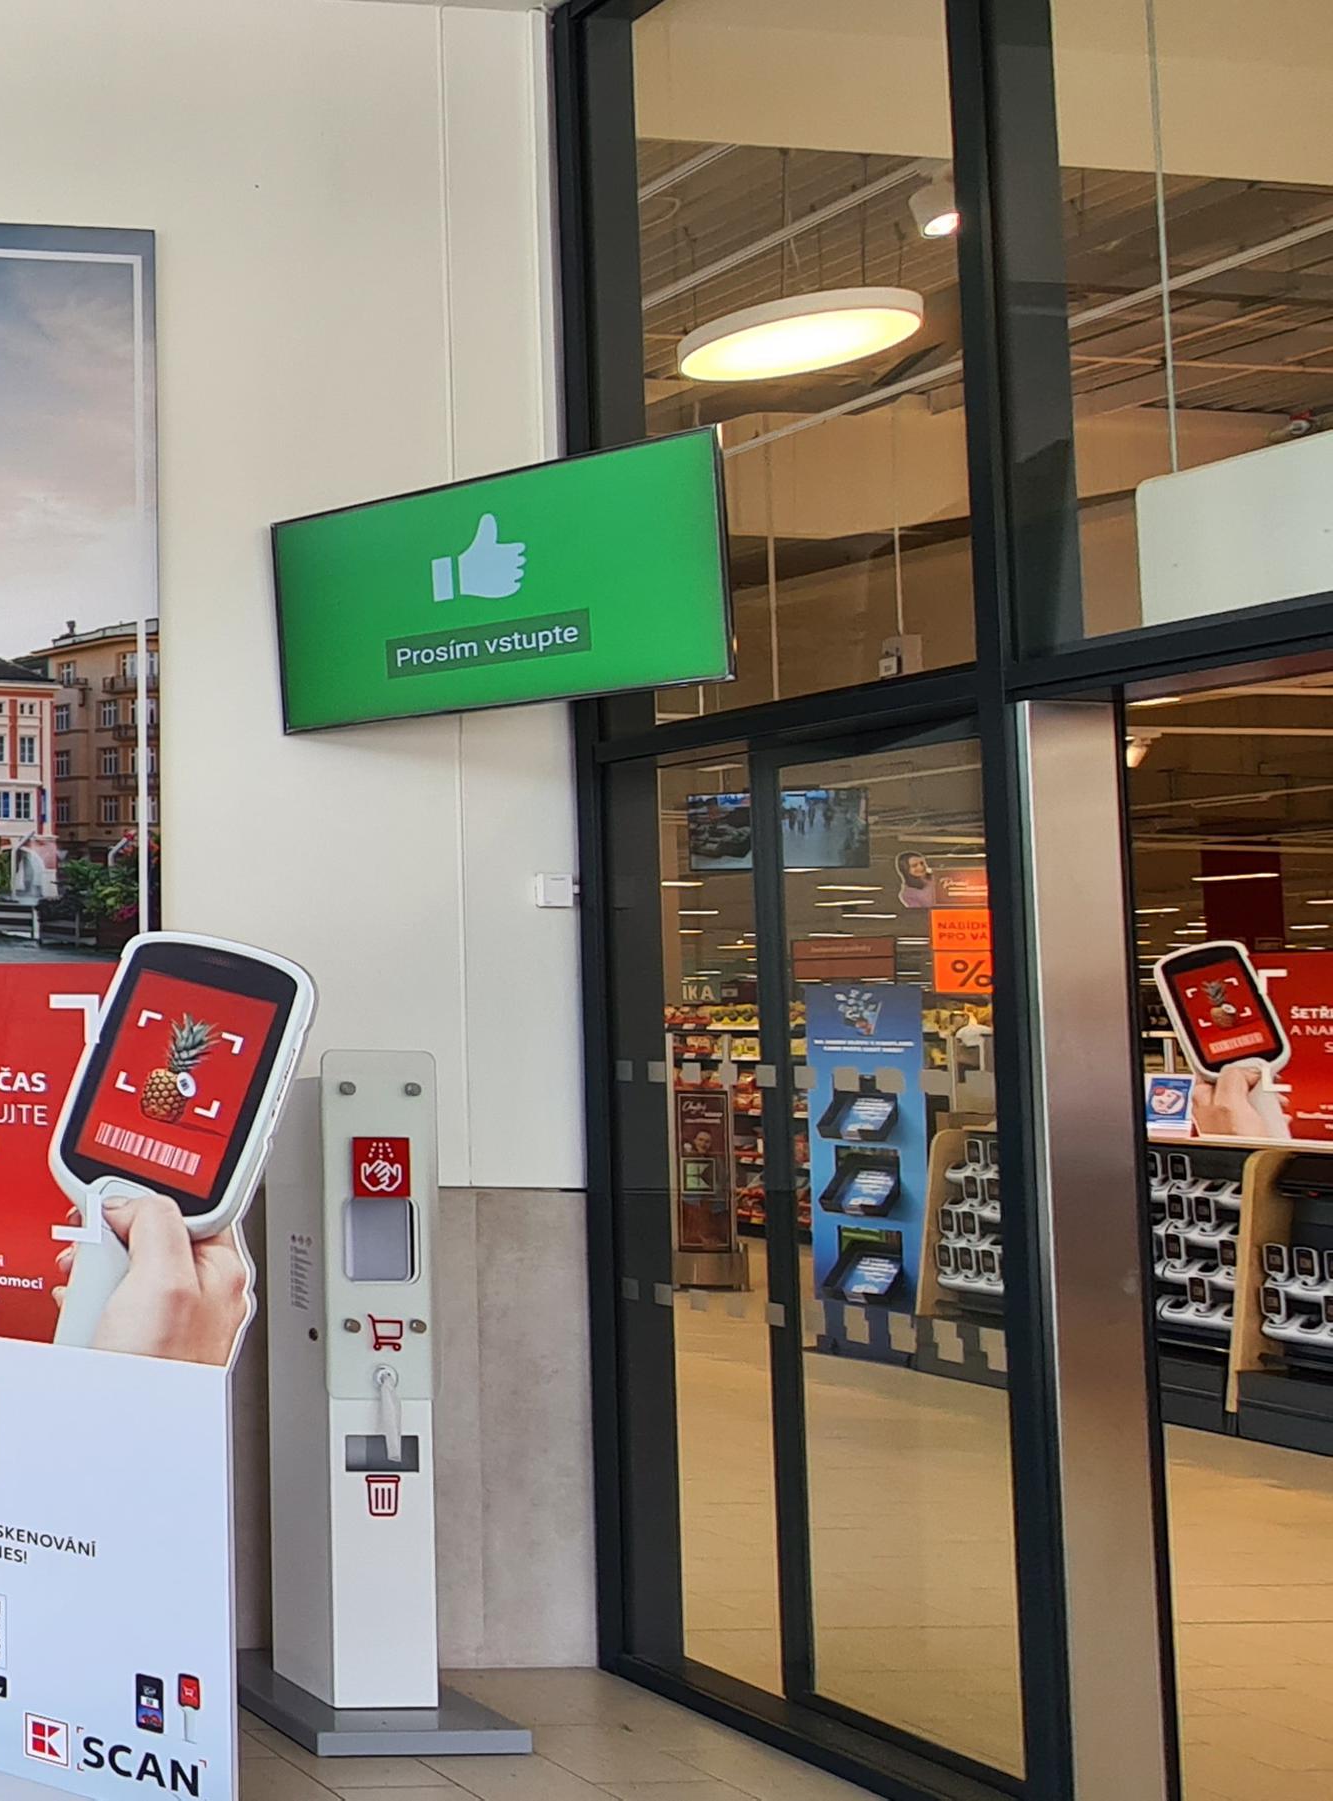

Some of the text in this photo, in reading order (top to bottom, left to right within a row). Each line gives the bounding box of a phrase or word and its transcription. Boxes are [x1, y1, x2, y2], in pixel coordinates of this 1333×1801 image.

[396, 625, 579, 668] Prosím vstupte
[939, 933, 965, 941] PRO
[1290, 1025, 1302, 1036] A
[83, 1736, 200, 1798] SCAN
